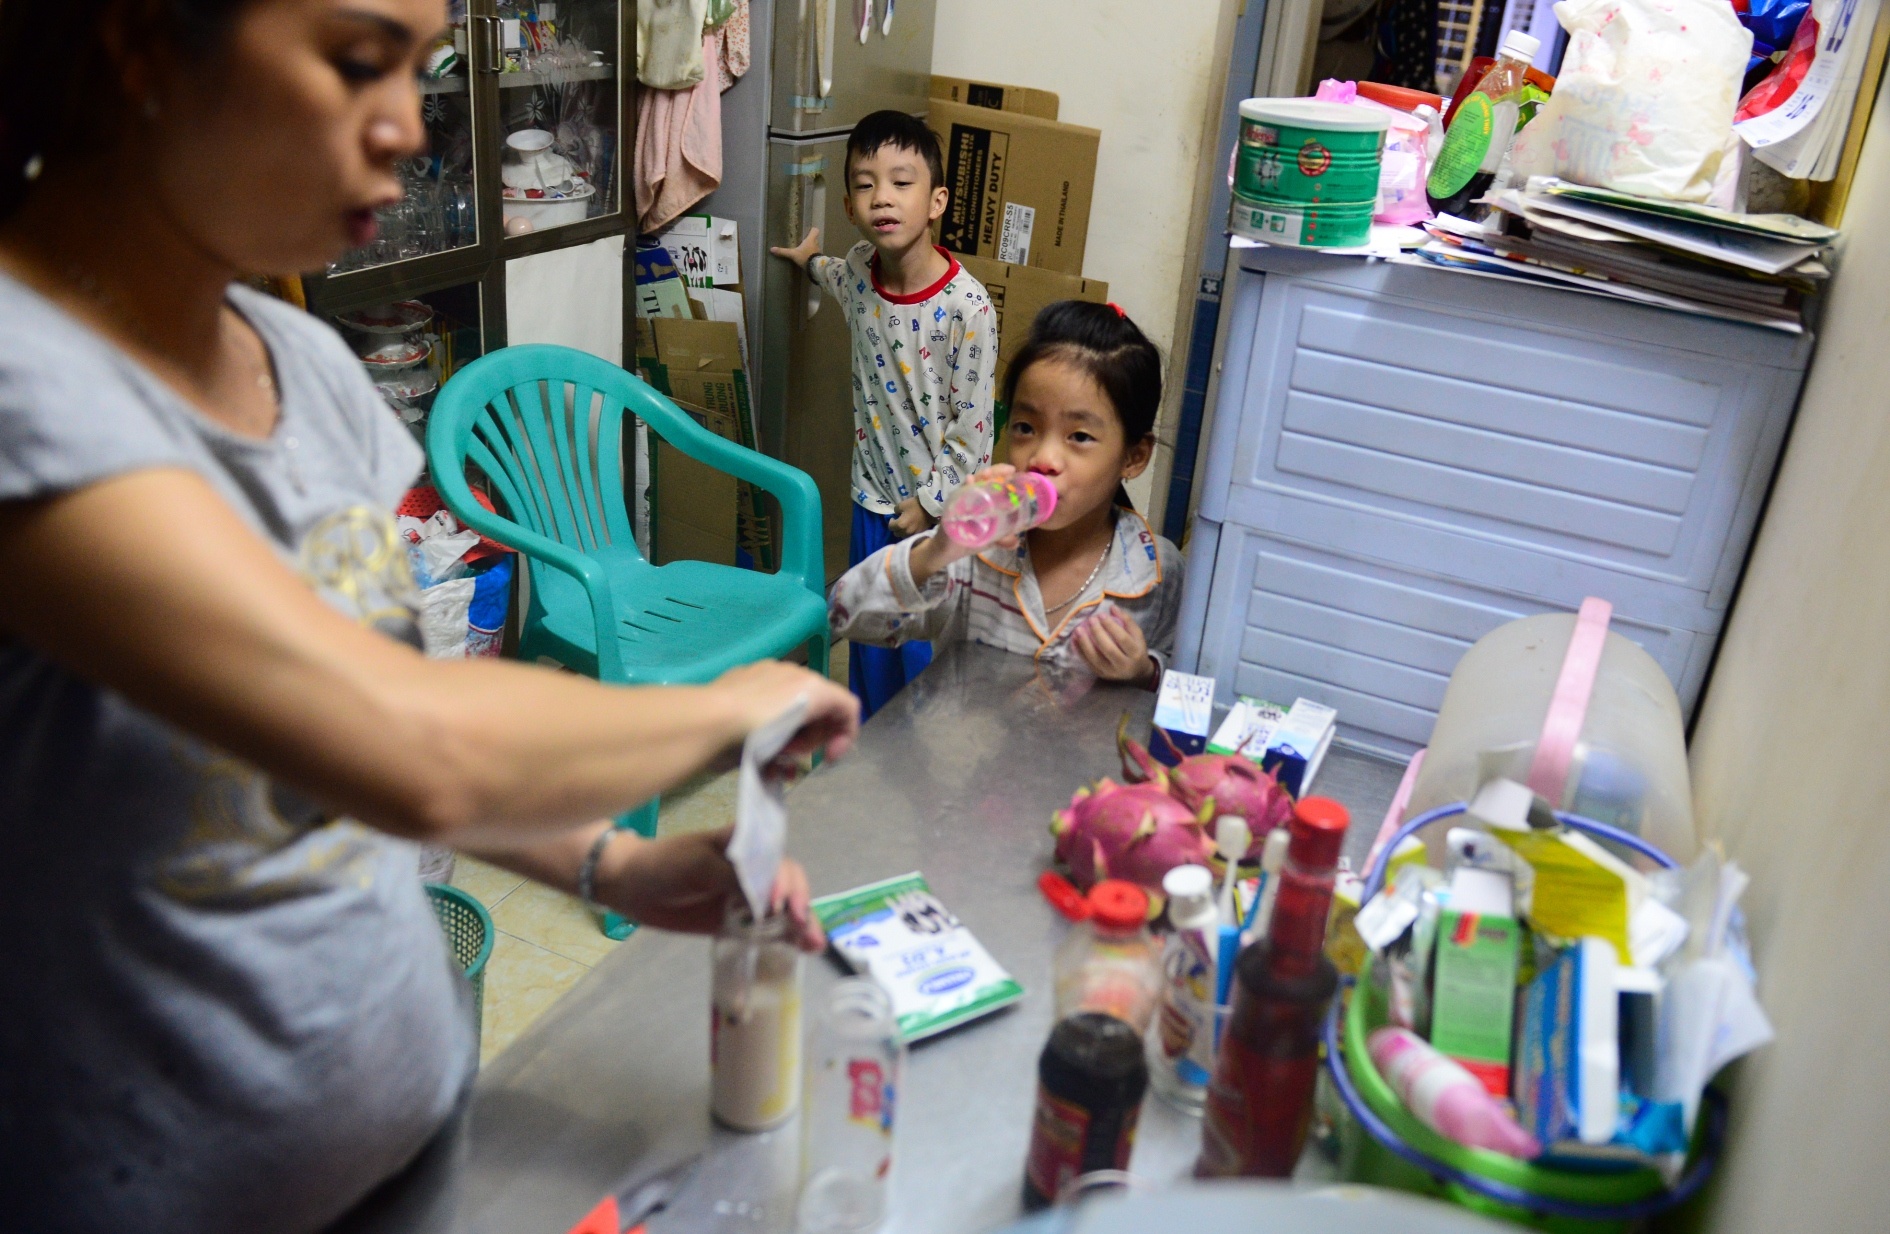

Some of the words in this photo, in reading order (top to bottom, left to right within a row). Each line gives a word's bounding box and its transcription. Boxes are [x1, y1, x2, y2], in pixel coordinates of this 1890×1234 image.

[952, 133, 970, 222] MITSUBISHI
[969, 148, 983, 220] CONDITIONERS
[982, 197, 996, 244] HEAVY
[989, 153, 1001, 193] DUTY
[1054, 225, 1063, 246] MADE
[1059, 181, 1069, 216] THAILAND
[1000, 205, 1013, 261] RC09CRR-S5
[876, 354, 885, 367] S
[919, 347, 931, 360] Z
[886, 380, 897, 393] C
[856, 428, 867, 441] Z
[934, 490, 943, 502] A
